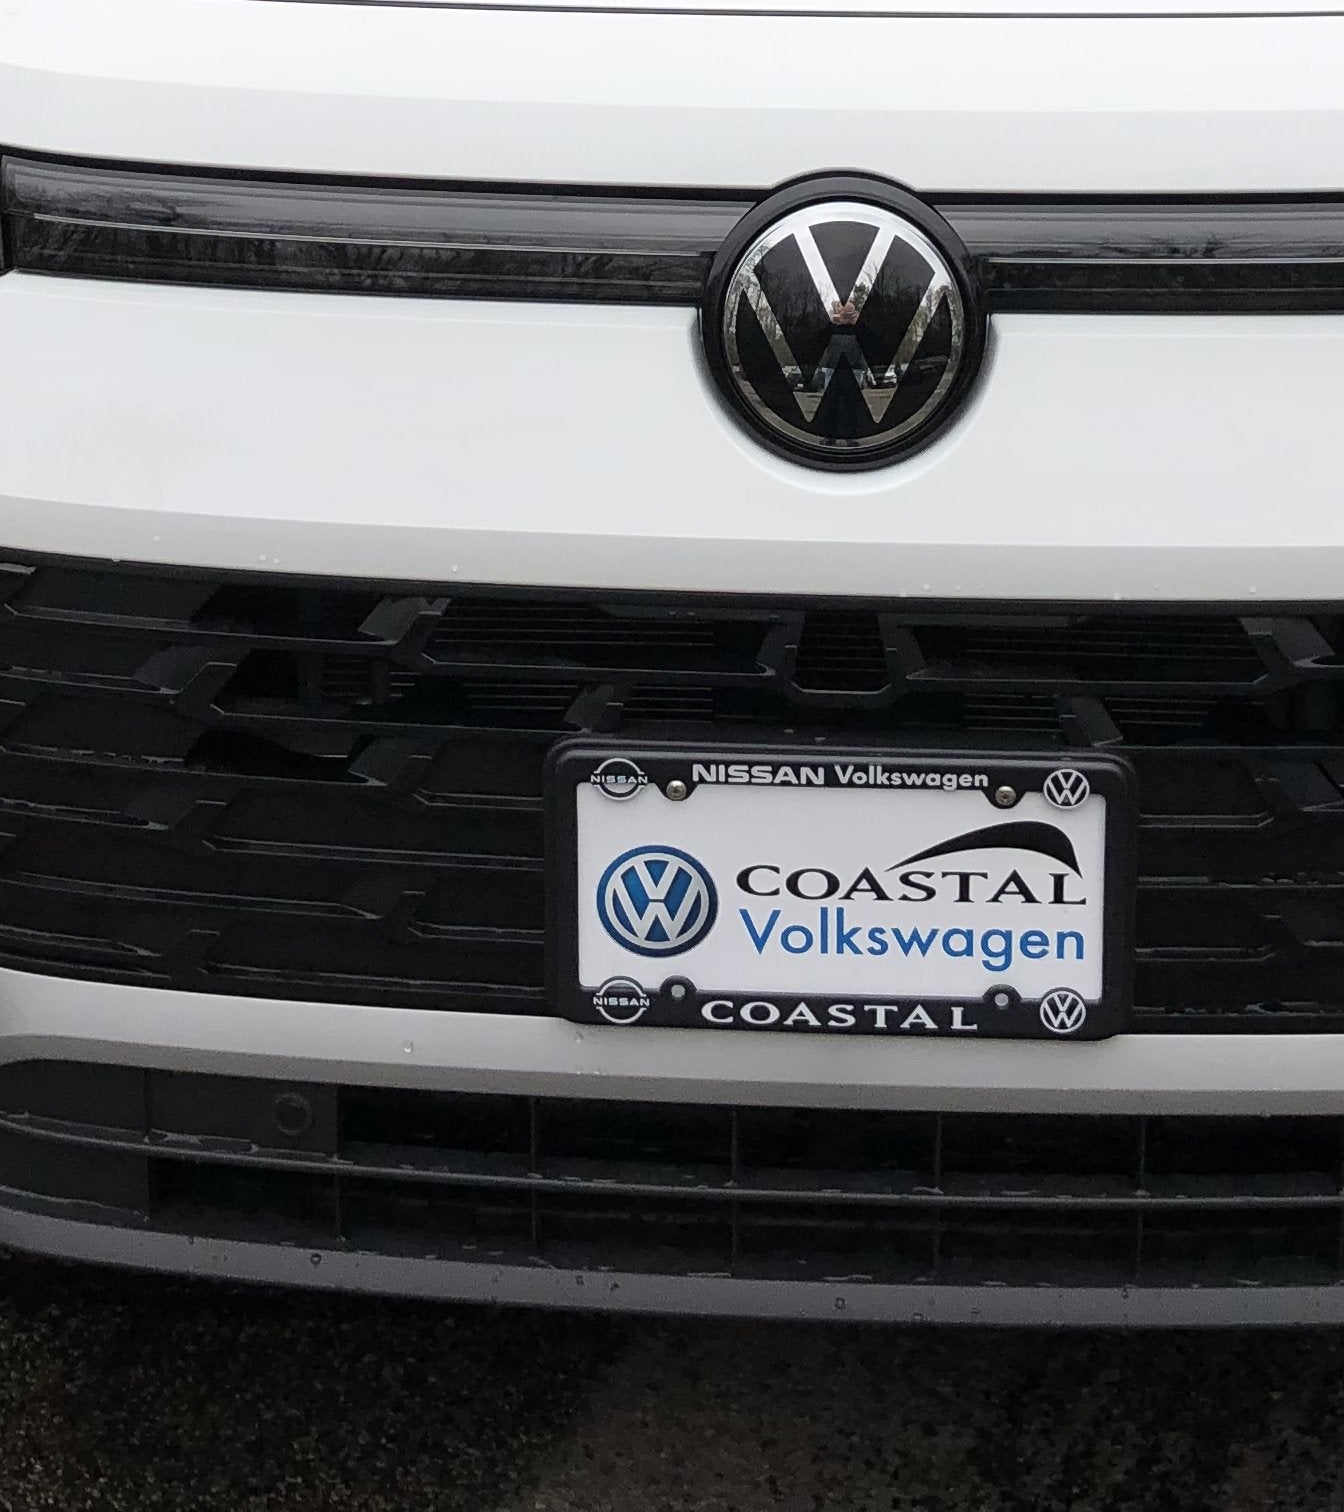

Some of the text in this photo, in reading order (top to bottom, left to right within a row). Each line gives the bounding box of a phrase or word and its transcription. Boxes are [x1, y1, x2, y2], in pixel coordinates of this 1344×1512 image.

[590, 773, 649, 786] NISSAN
[692, 764, 989, 791] NISSAN Volkswagen
[736, 865, 1087, 906] COASTAL
[739, 907, 1085, 972] Volkswagen
[593, 995, 650, 1007] NISSAN
[700, 999, 978, 1031] COASTAL
